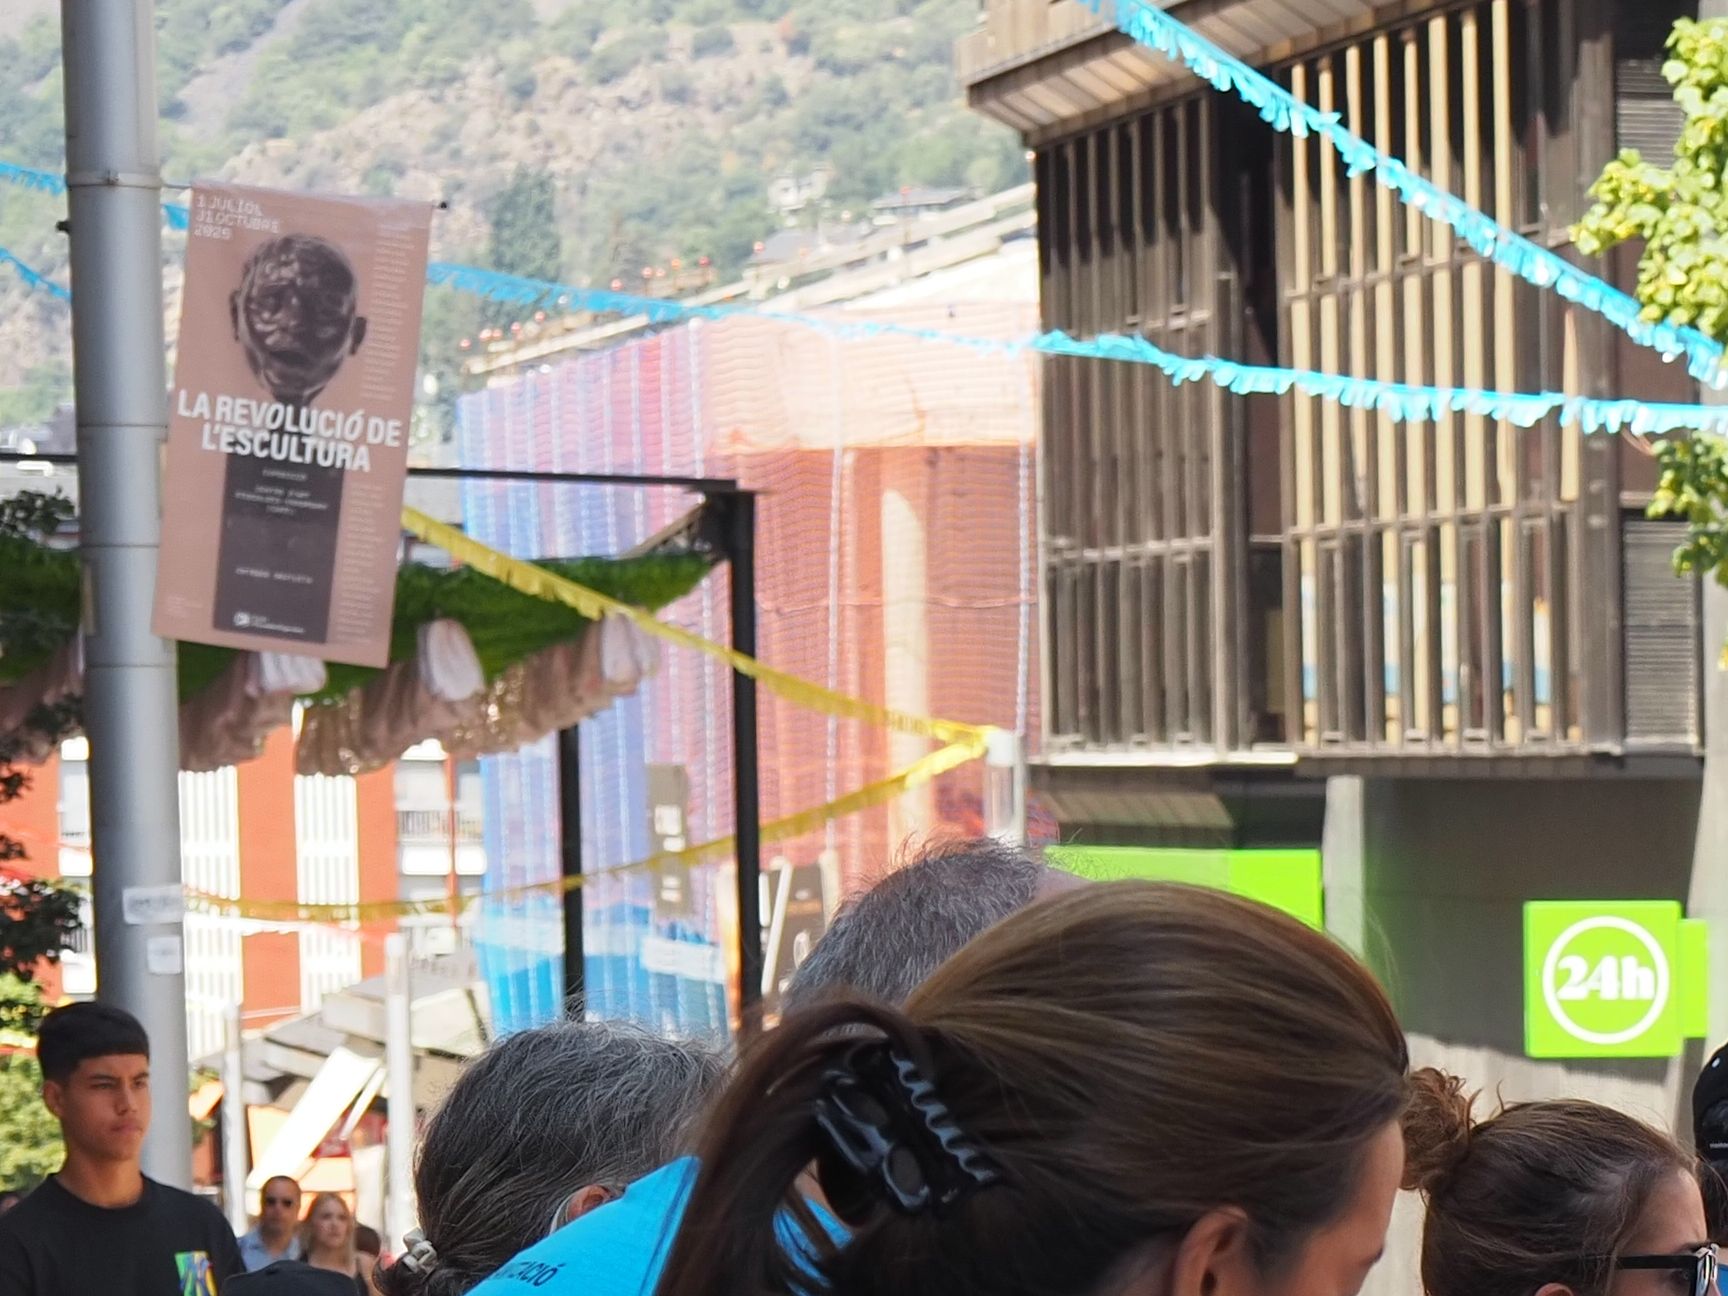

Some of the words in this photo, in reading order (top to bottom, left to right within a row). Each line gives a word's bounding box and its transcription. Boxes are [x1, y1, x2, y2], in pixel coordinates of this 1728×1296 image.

[177, 389, 211, 420] LA
[214, 395, 366, 441] REVOLUCIÓ
[365, 416, 402, 448] DE
[201, 423, 371, 473] L'ESCULTURA
[1555, 955, 1656, 1001] 24h
